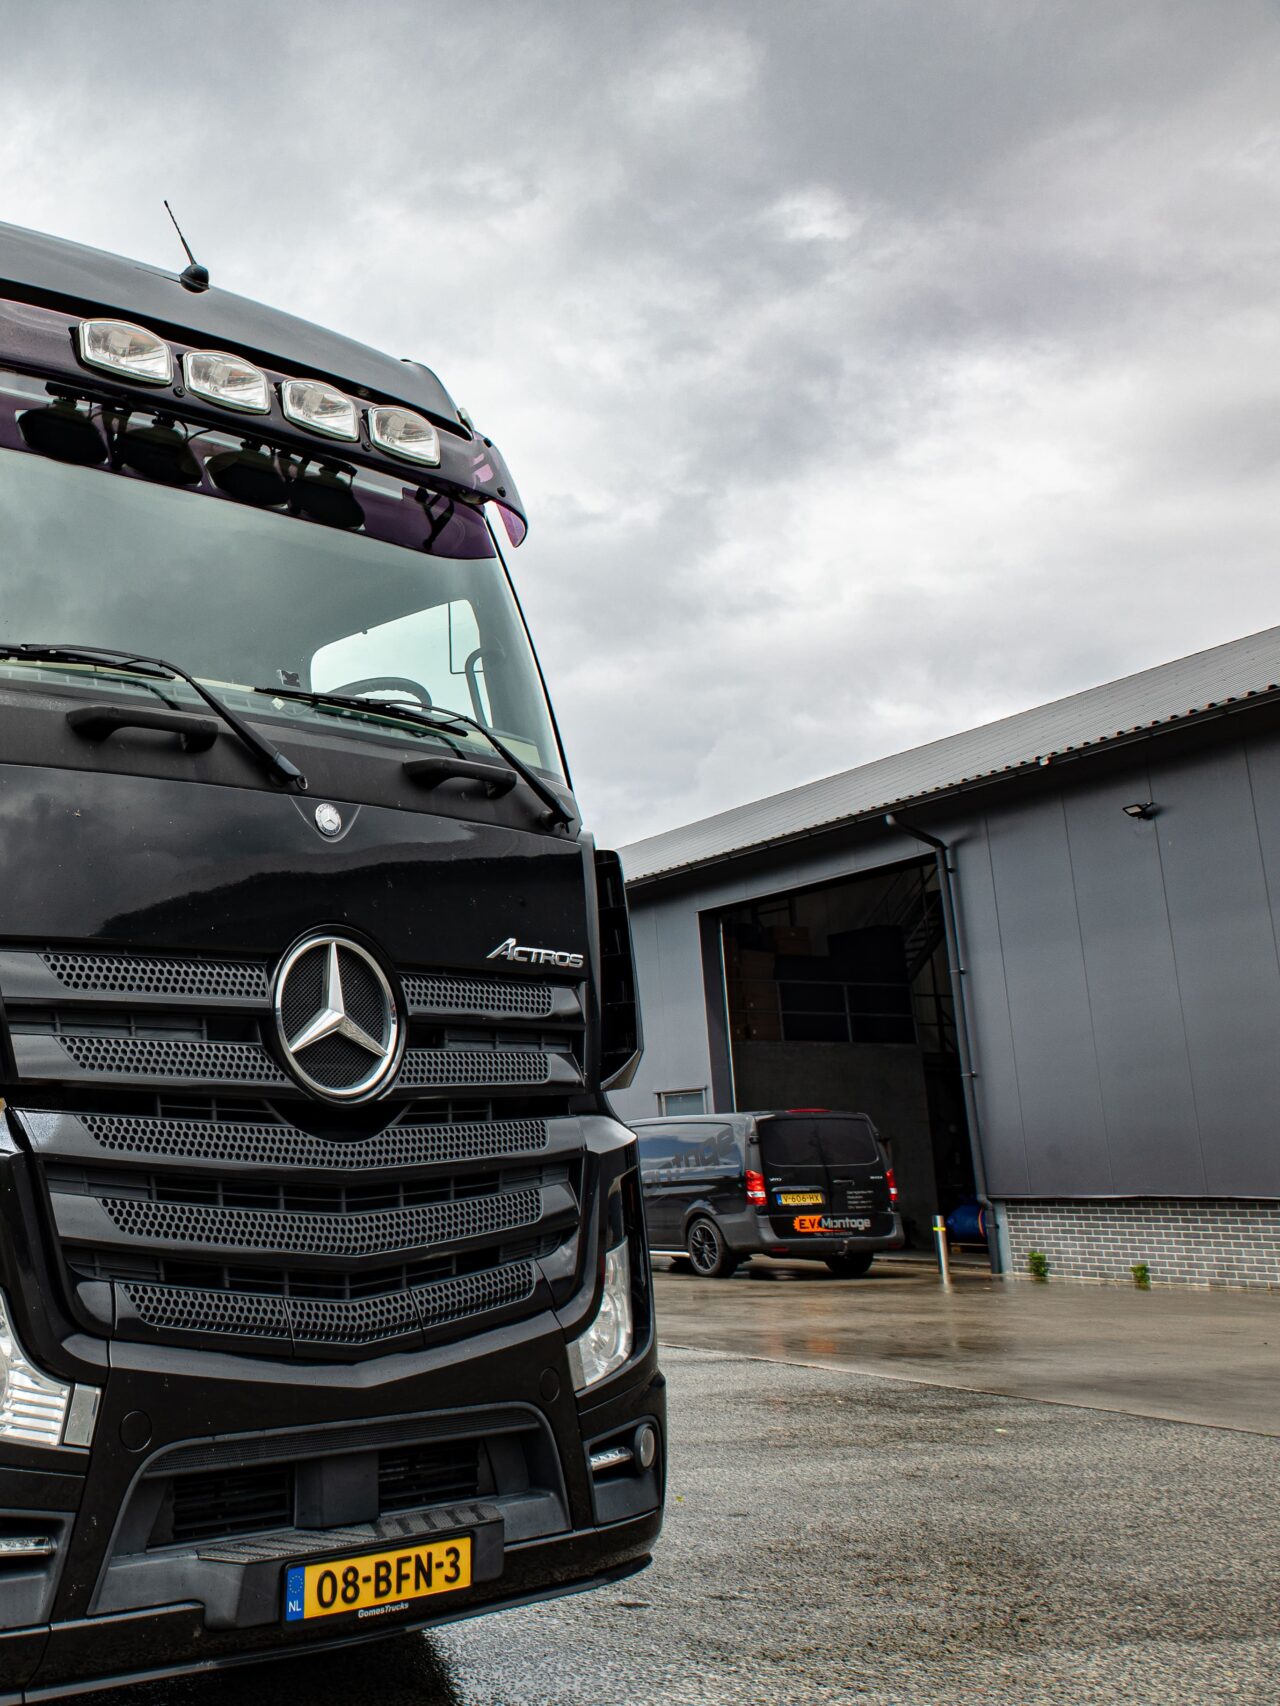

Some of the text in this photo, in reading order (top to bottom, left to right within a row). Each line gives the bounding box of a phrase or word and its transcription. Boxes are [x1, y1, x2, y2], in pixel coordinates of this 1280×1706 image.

[486, 937, 584, 968] ACTROS
[821, 1217, 871, 1231] Montage
[316, 1547, 461, 1609] 08-BFN-3
[288, 1600, 302, 1612] NL
